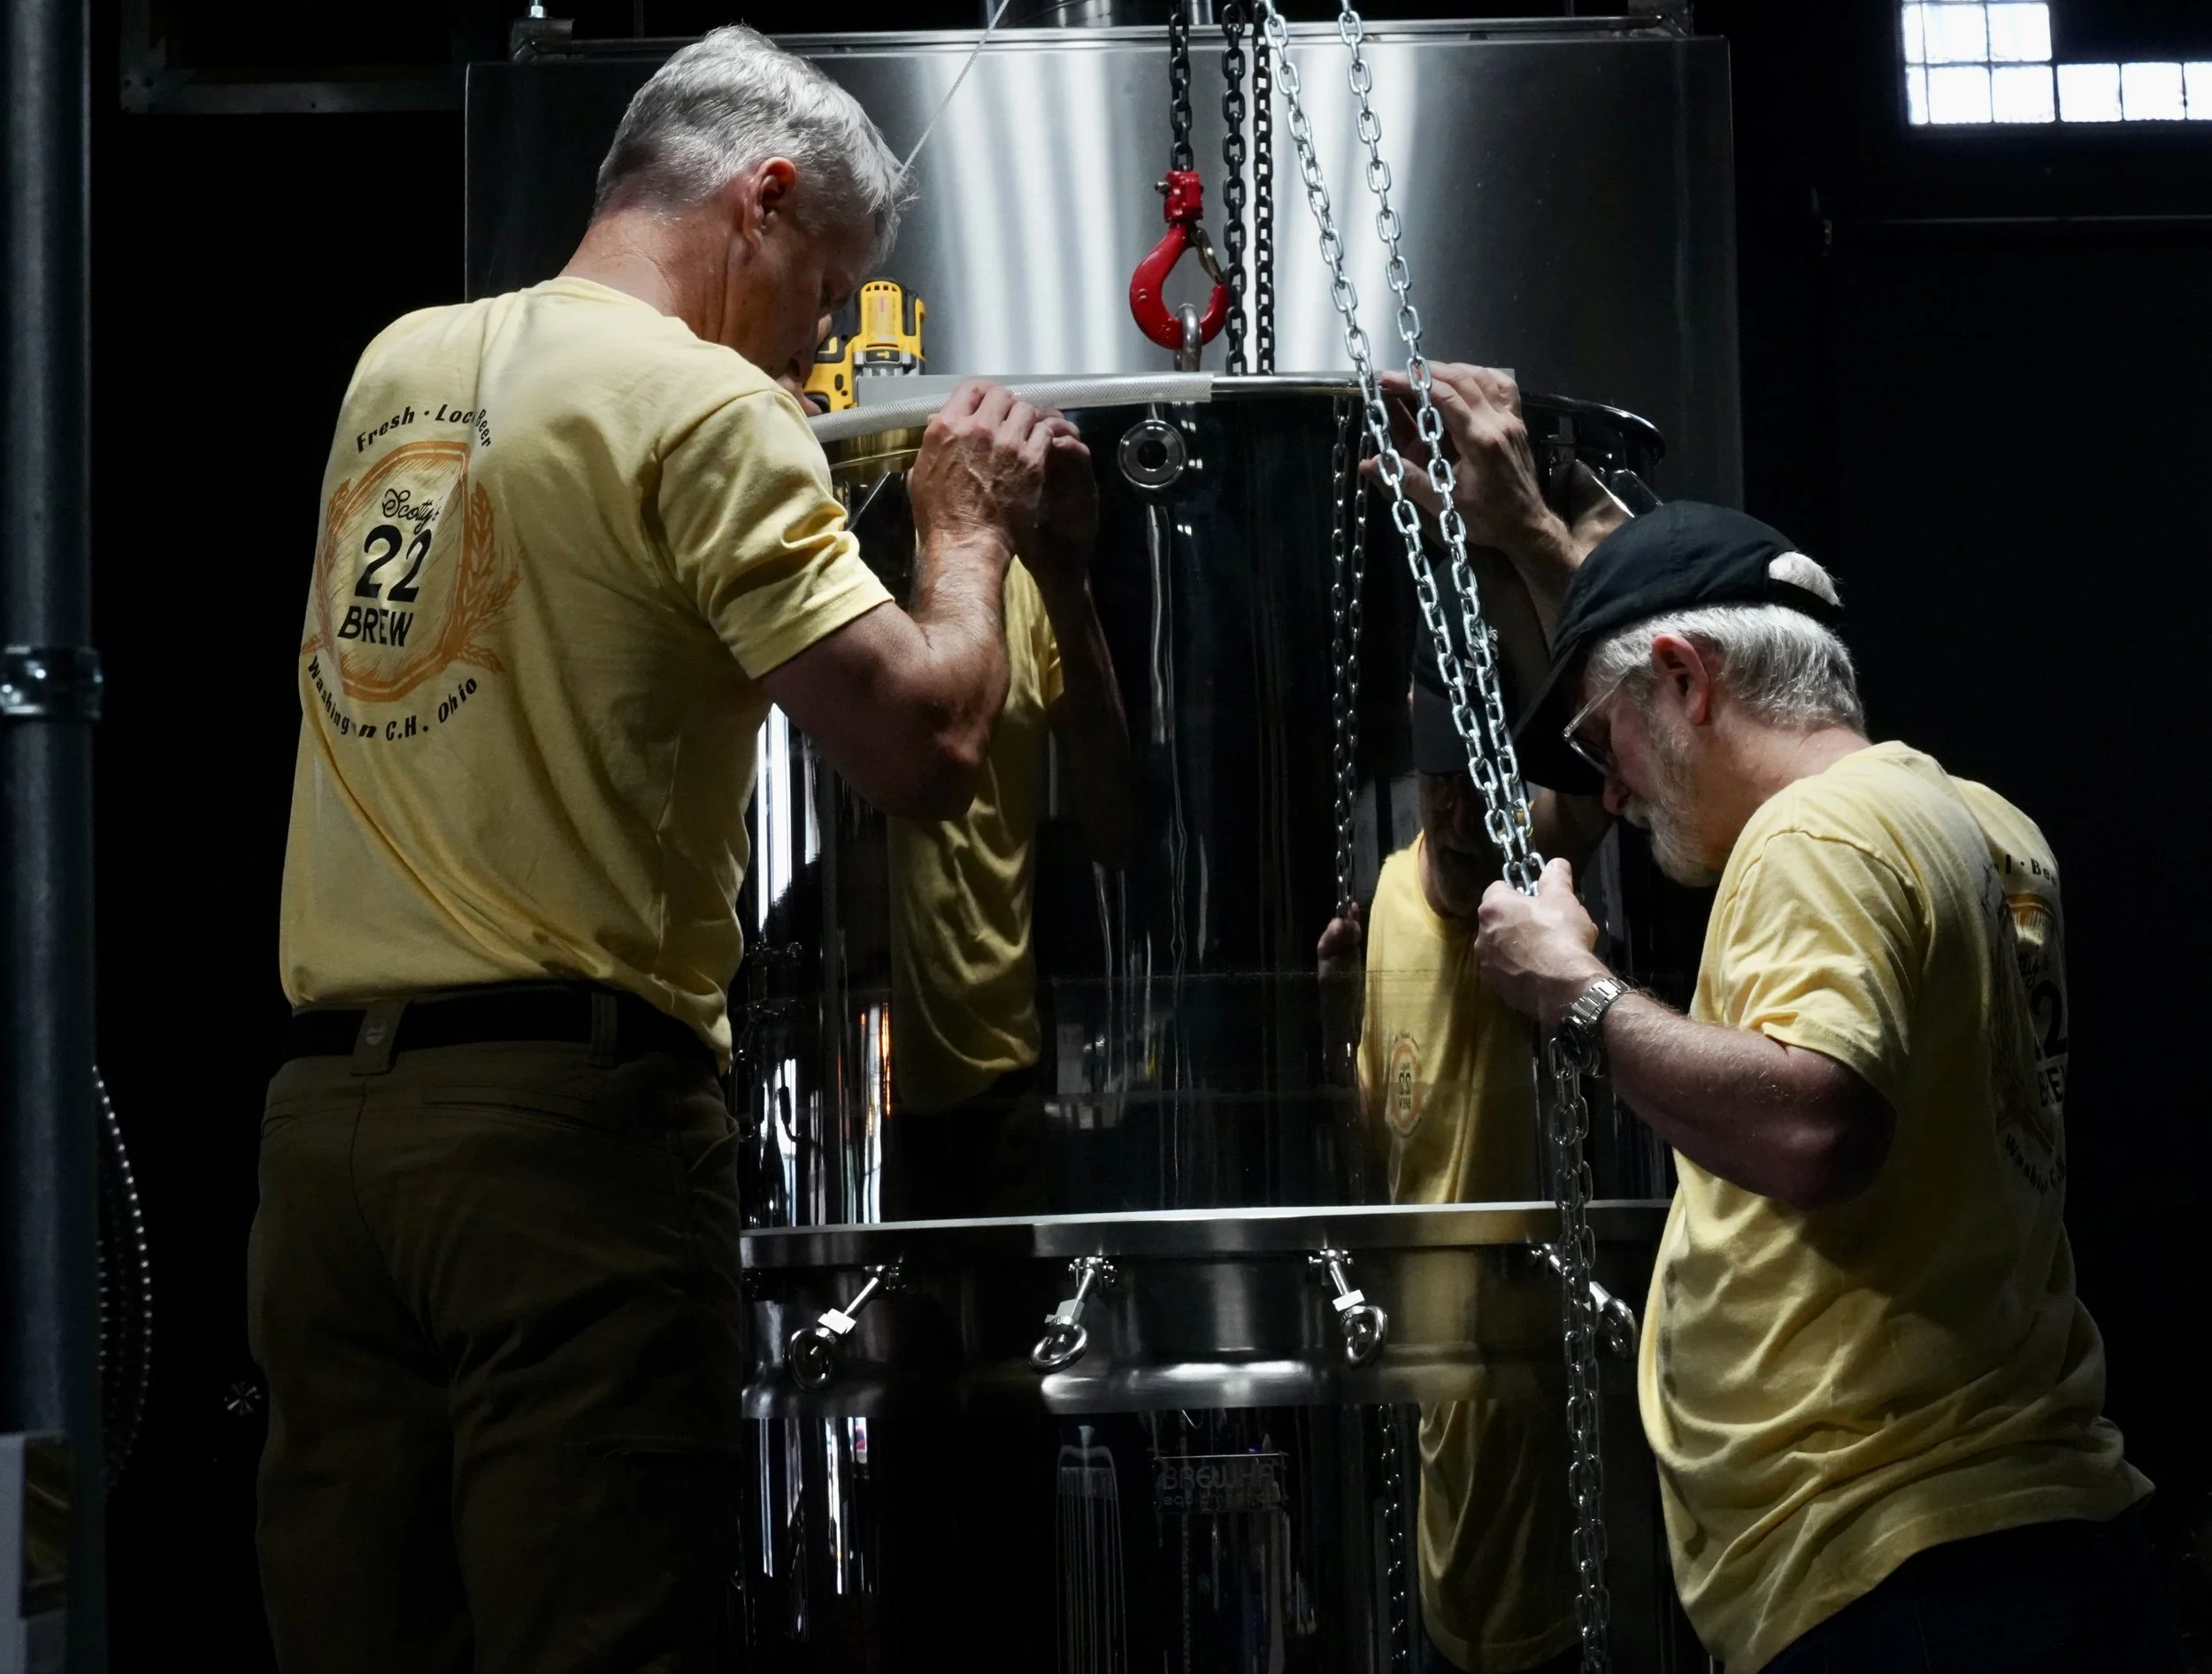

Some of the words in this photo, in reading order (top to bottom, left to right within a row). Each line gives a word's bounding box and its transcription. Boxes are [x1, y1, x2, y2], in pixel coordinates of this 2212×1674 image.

[357, 406, 414, 453] Fresh
[435, 404, 475, 424] Loc
[475, 409, 492, 447] Beer
[354, 525, 432, 603] 22
[337, 606, 414, 647] BREW
[308, 655, 377, 738] Washingn
[438, 679, 477, 724] Ohio
